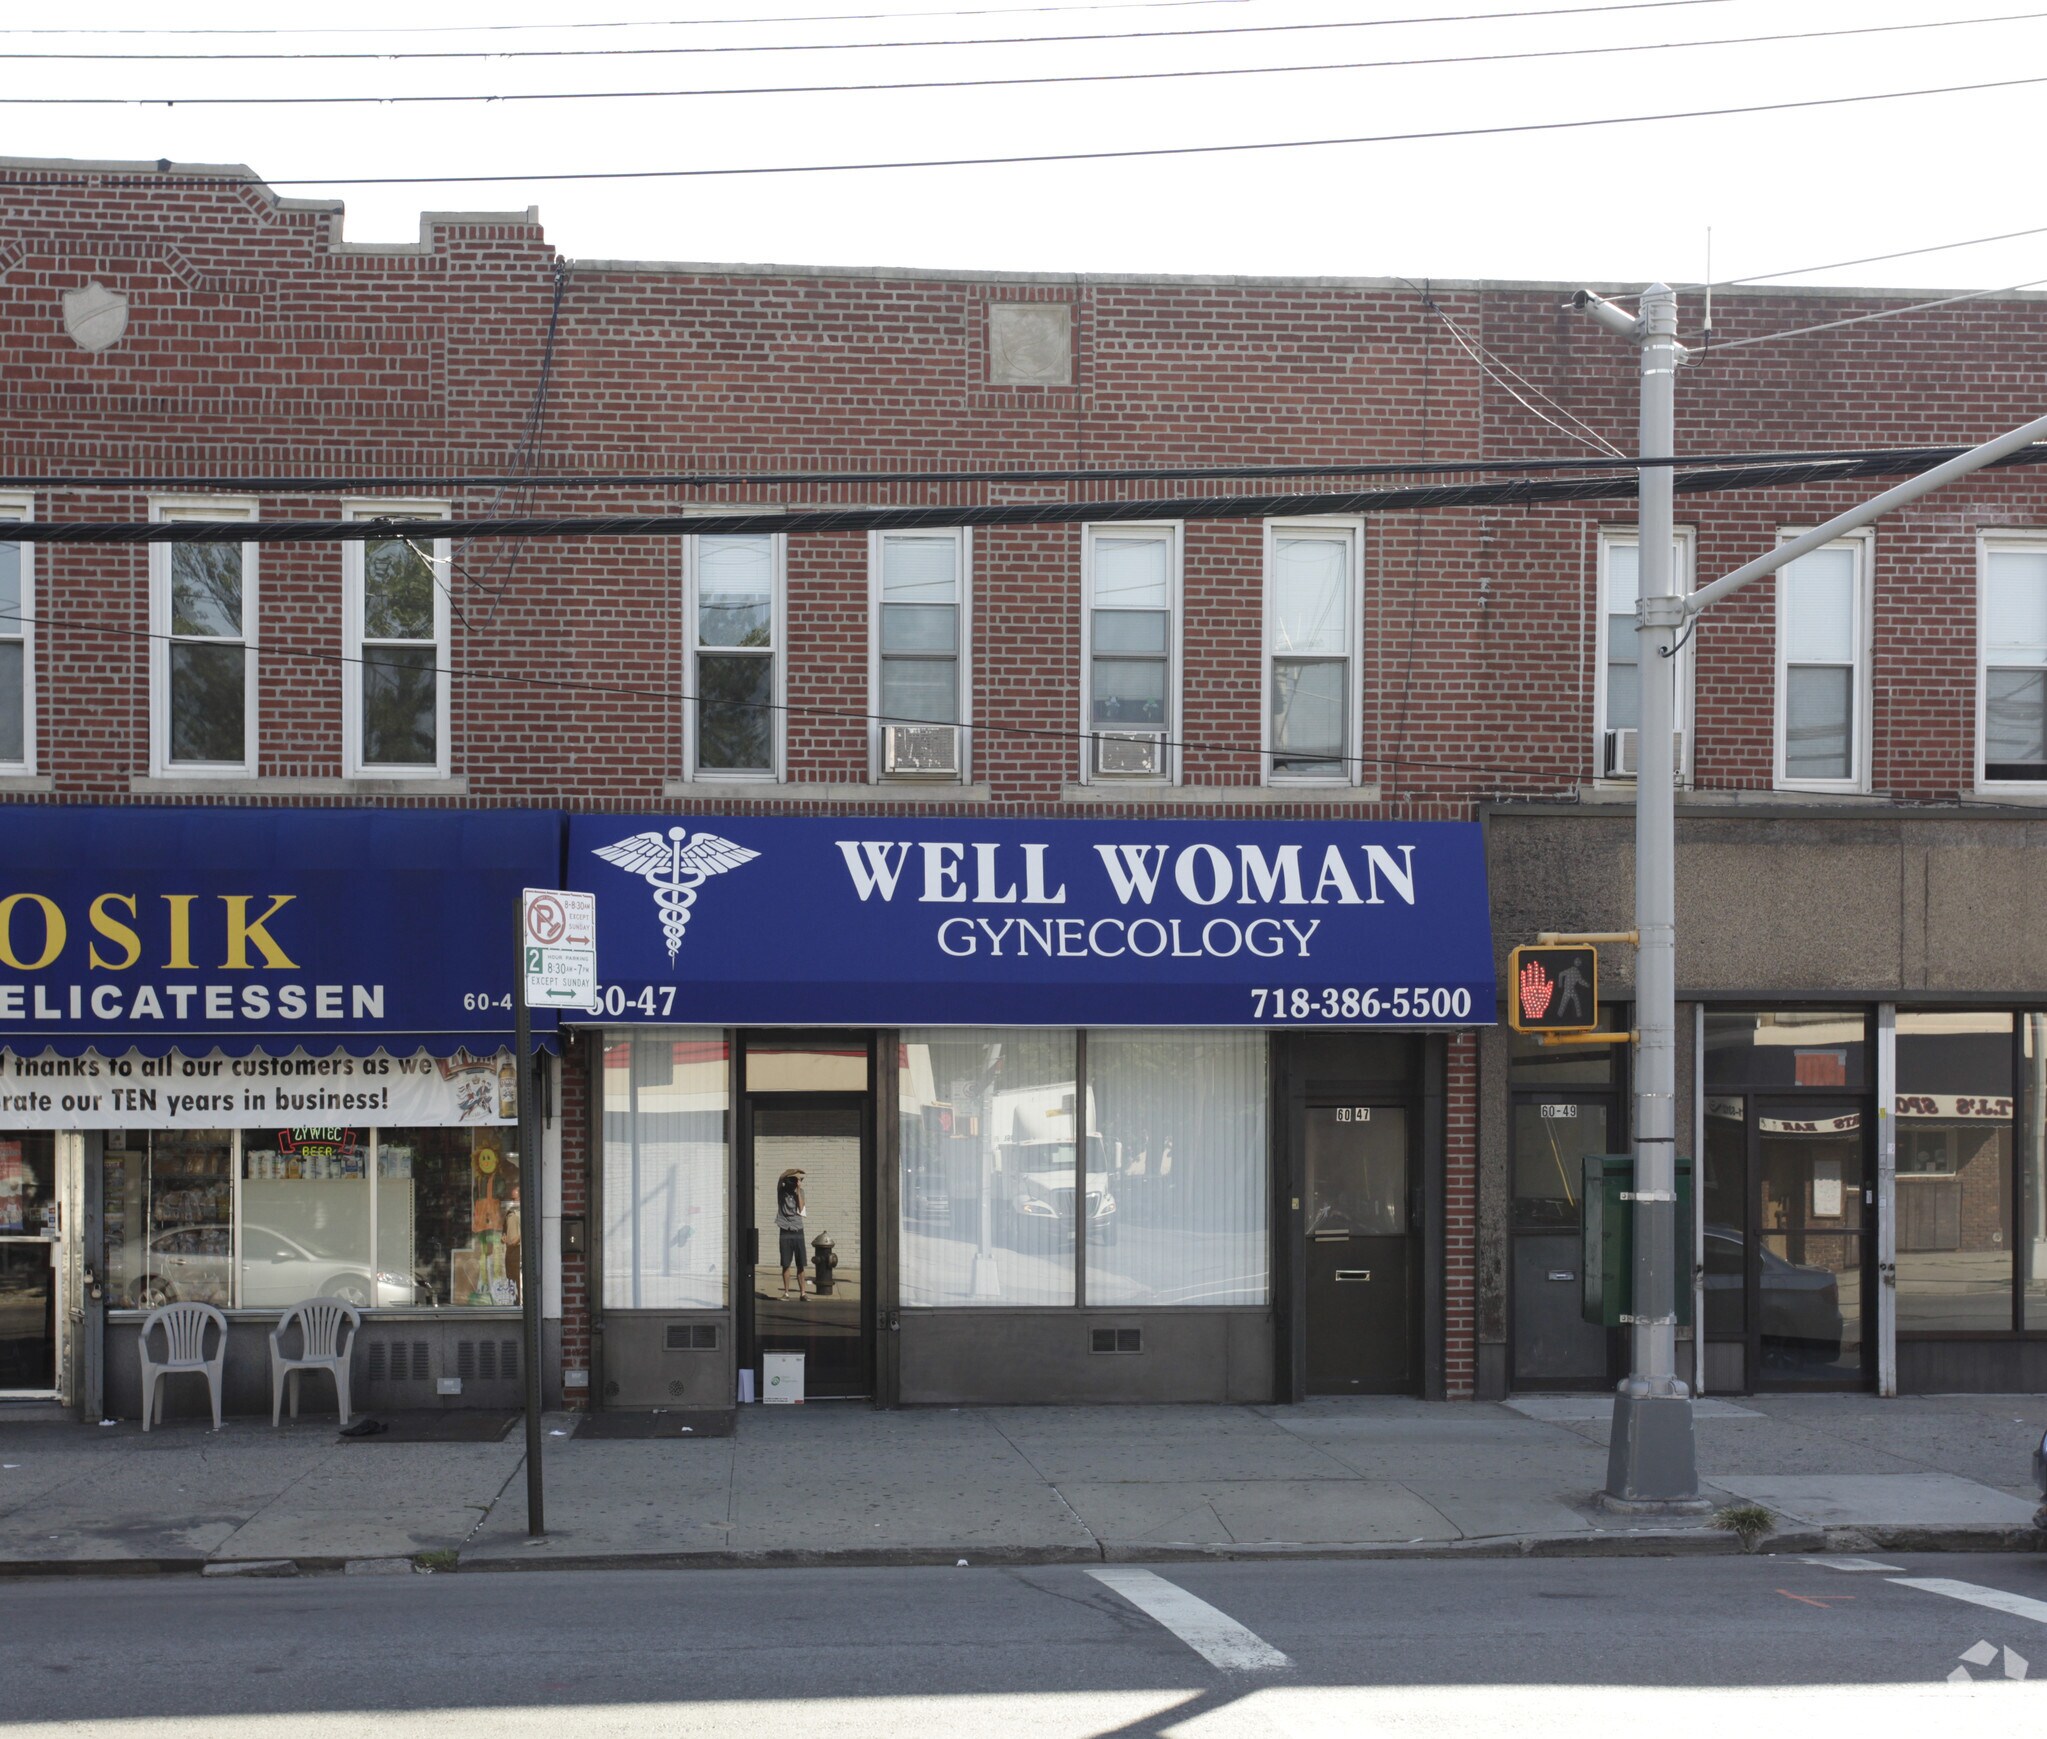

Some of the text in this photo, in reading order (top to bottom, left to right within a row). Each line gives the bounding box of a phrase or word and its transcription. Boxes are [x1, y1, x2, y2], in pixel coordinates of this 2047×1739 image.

[834, 841, 1416, 906] WELL WOMAN
[568, 923, 590, 931] SUNDAY
[569, 912, 589, 921] EXCEPT
[0, 892, 301, 970] OSIK
[937, 917, 1321, 957] GYNECOLOGY
[529, 949, 540, 972] 2
[531, 976, 590, 988] EXCEPT SUNDAY
[0, 985, 385, 1020] ELICATESSEN
[463, 993, 513, 1011] 60-4
[1250, 987, 1472, 1018] 718-386-5500
[15, 1057, 100, 1077] thanks
[109, 1058, 132, 1077] to
[141, 1053, 172, 1077] all
[182, 1059, 223, 1077] our
[231, 1057, 354, 1077] customers
[362, 1058, 390, 1075] as
[398, 1057, 432, 1075] we
[0, 1086, 388, 1117] rate our TEN years in business!
[1542, 1105, 1576, 1117] 60-49
[1338, 1108, 1369, 1121] 60 47
[302, 1146, 333, 1157] BEER
